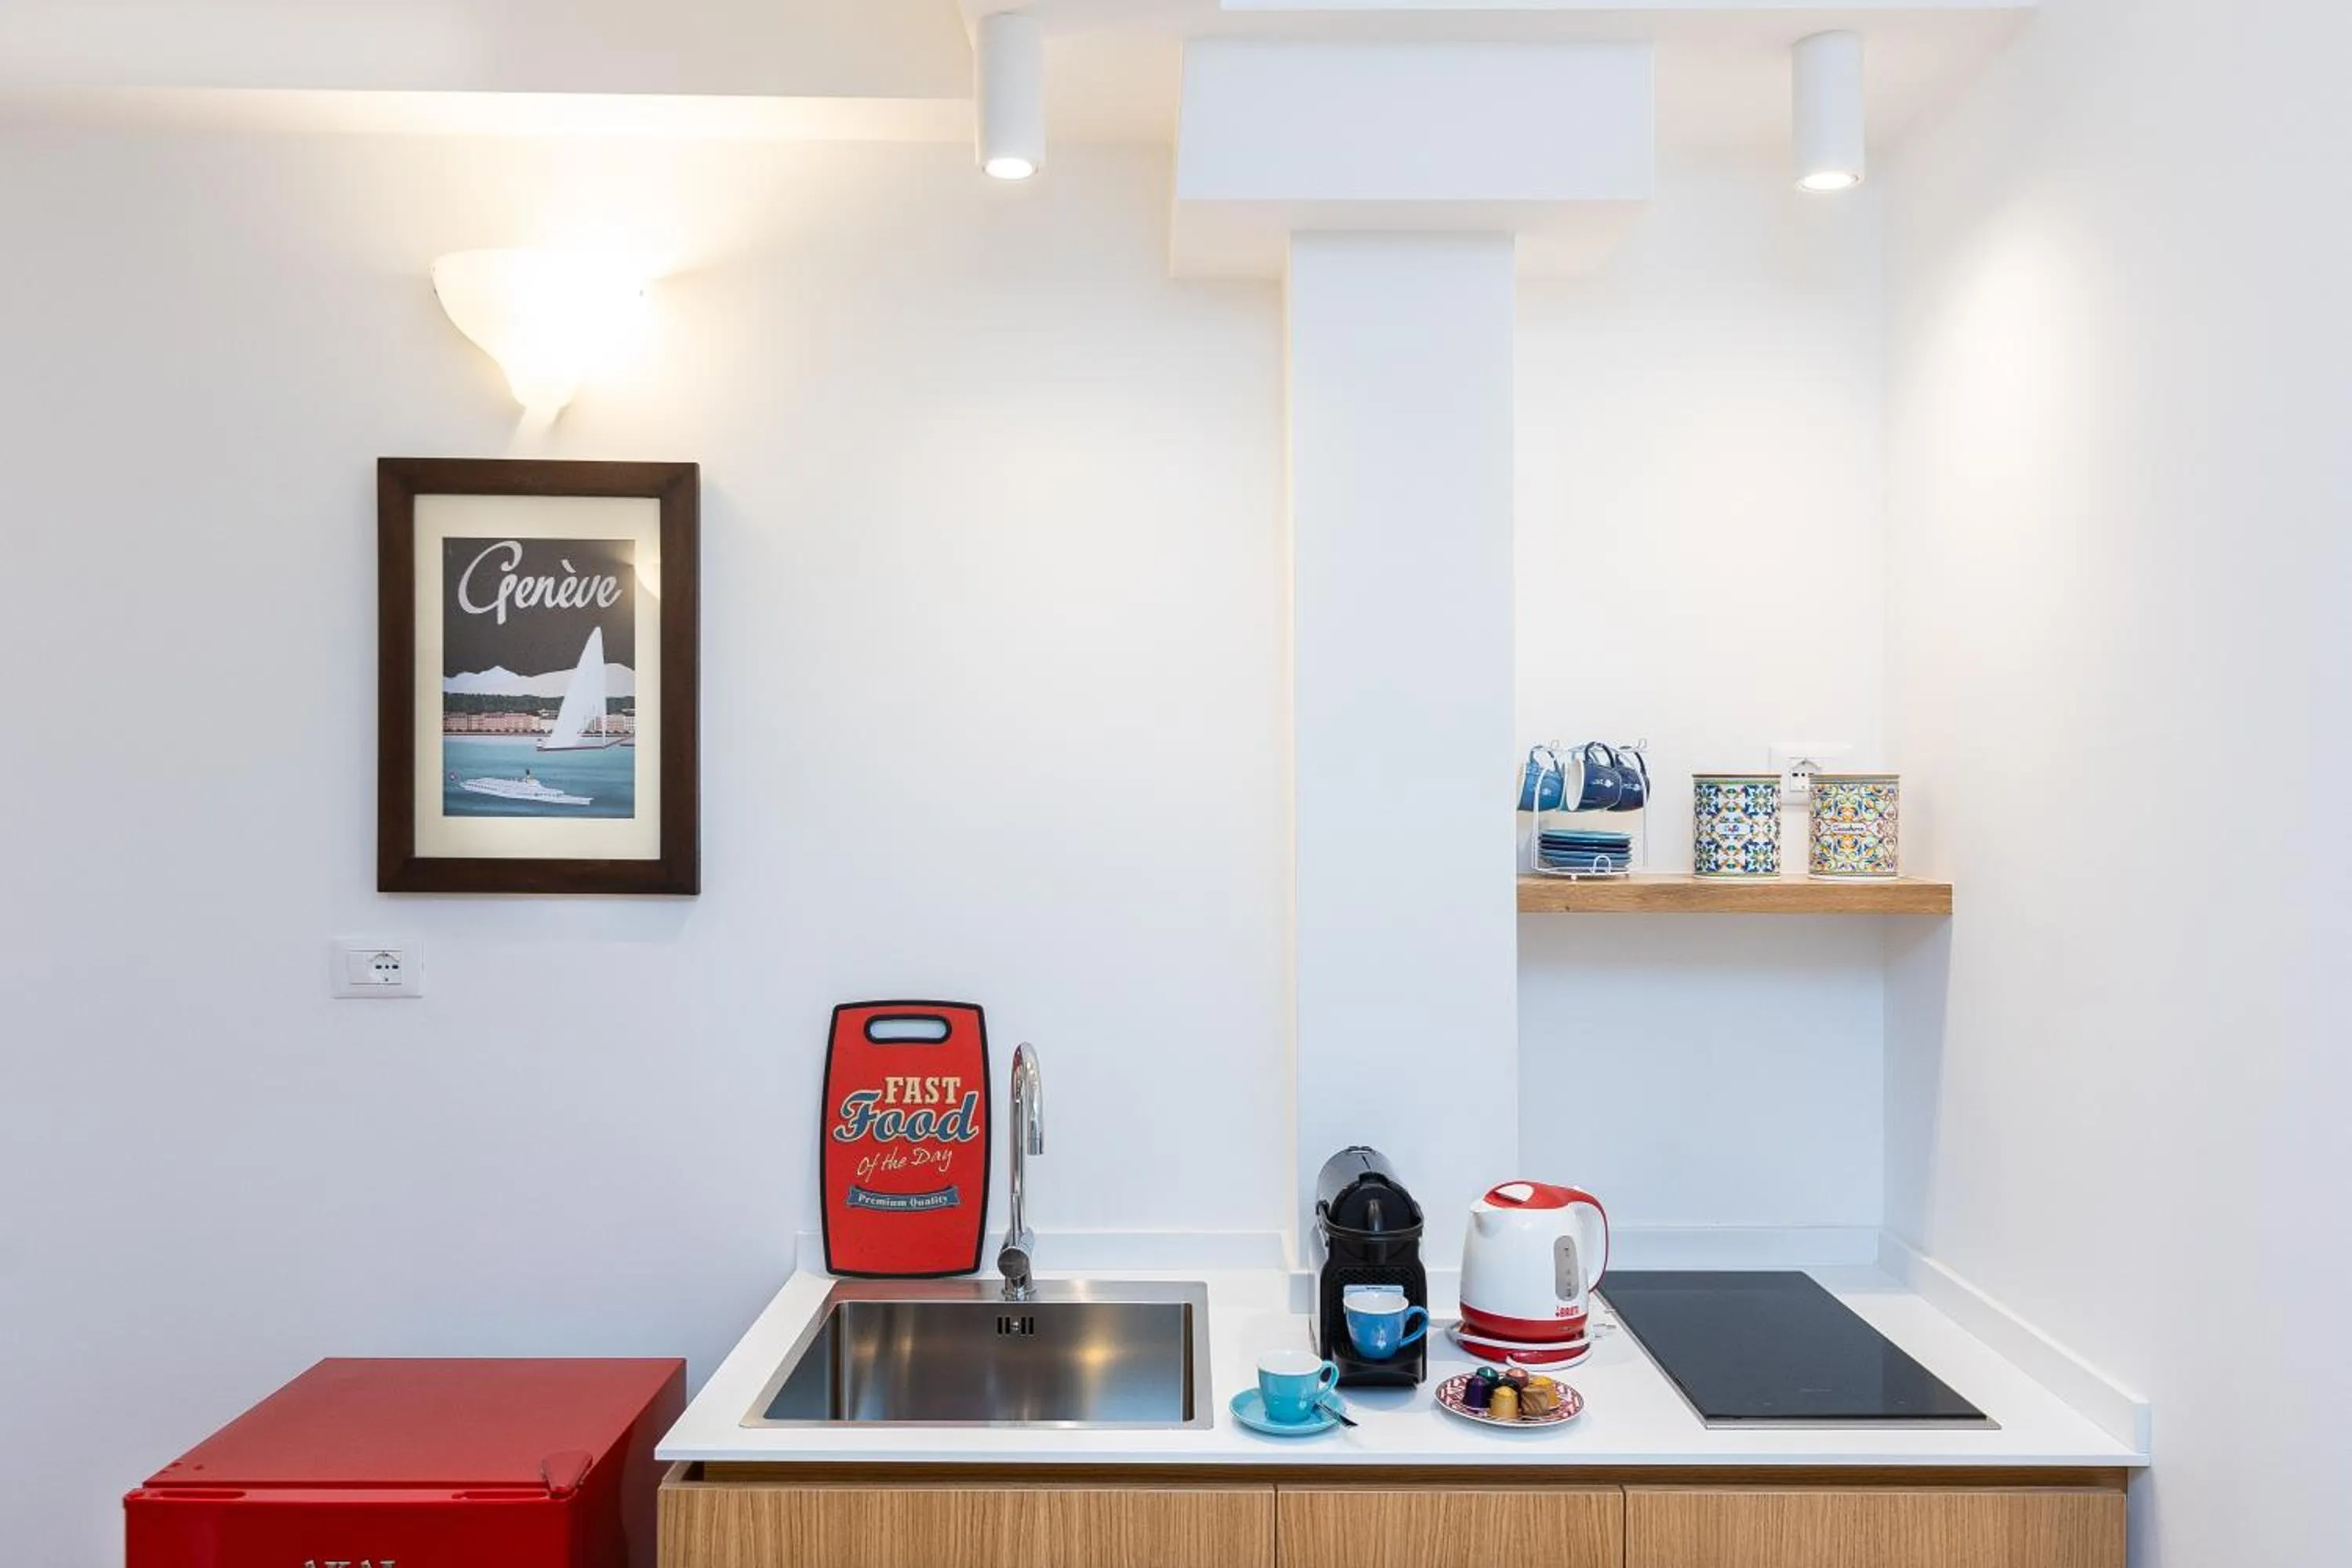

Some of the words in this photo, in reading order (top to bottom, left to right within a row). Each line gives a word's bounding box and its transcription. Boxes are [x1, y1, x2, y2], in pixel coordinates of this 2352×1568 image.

[458, 540, 623, 624] Genève
[884, 1076, 961, 1105] FAST
[833, 1089, 980, 1143] Food
[880, 1145, 907, 1171] the
[909, 1147, 953, 1172] Day
[858, 1192, 907, 1207] Premium
[909, 1195, 948, 1207] Quality
